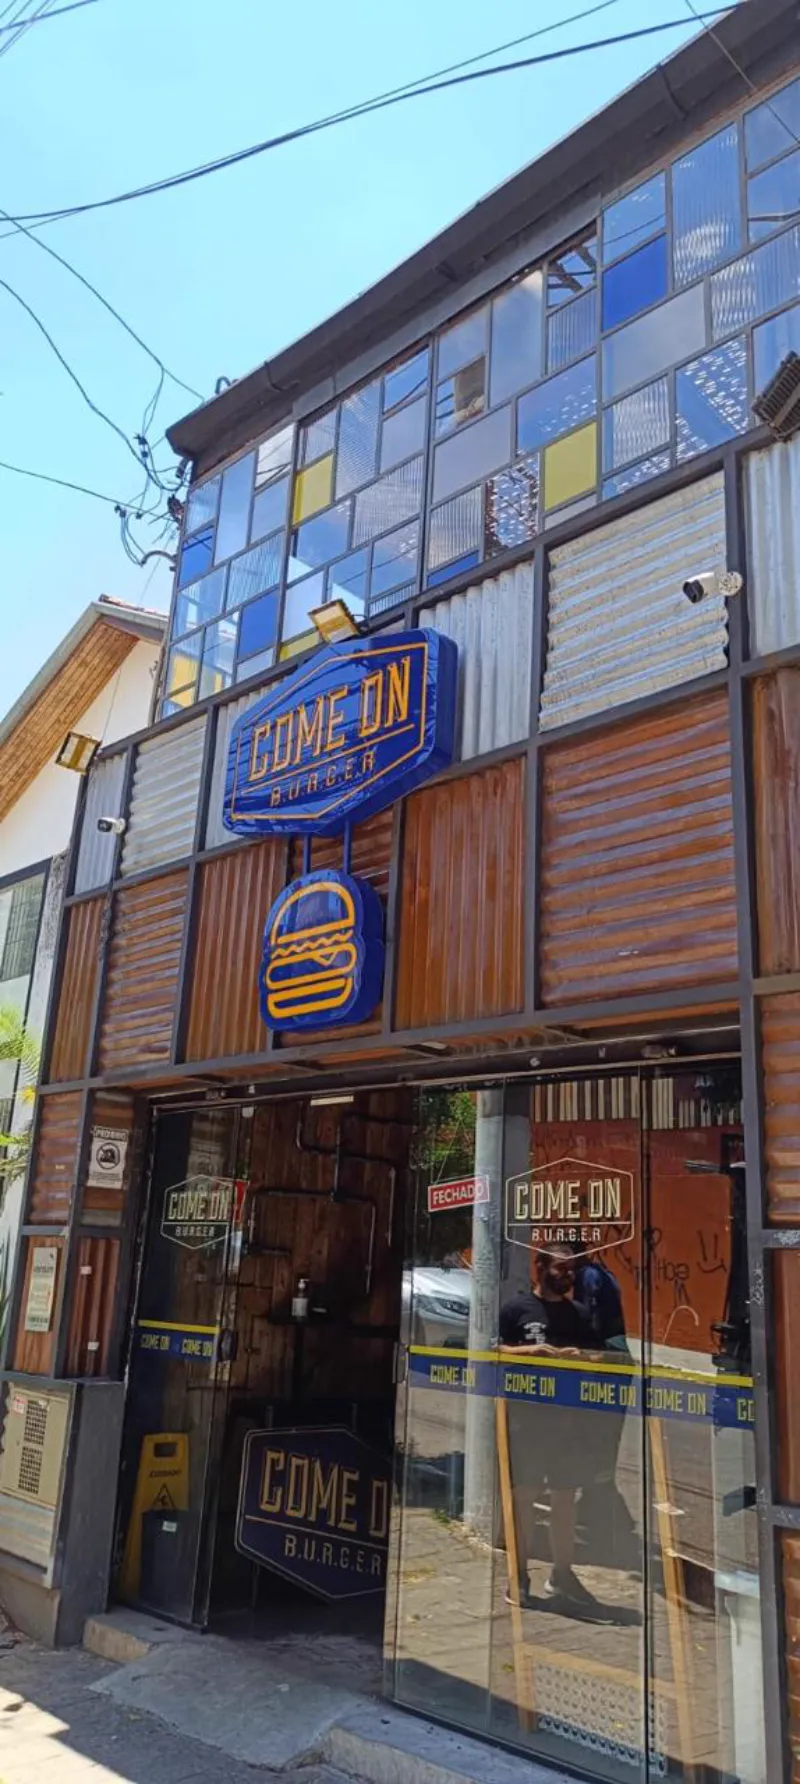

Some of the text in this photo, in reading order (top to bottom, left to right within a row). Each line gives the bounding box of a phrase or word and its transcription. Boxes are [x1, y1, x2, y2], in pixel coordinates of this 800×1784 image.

[248, 655, 412, 782] COME ON
[168, 1189, 230, 1220] COME ON
[432, 1183, 484, 1205] FECHADO
[514, 1177, 621, 1220] COME ON
[429, 1363, 475, 1389] COME ON
[504, 1373, 556, 1398] COME ON
[580, 1380, 636, 1407] COME ON
[646, 1388, 706, 1416] COME ON
[259, 1448, 360, 1532] COME
